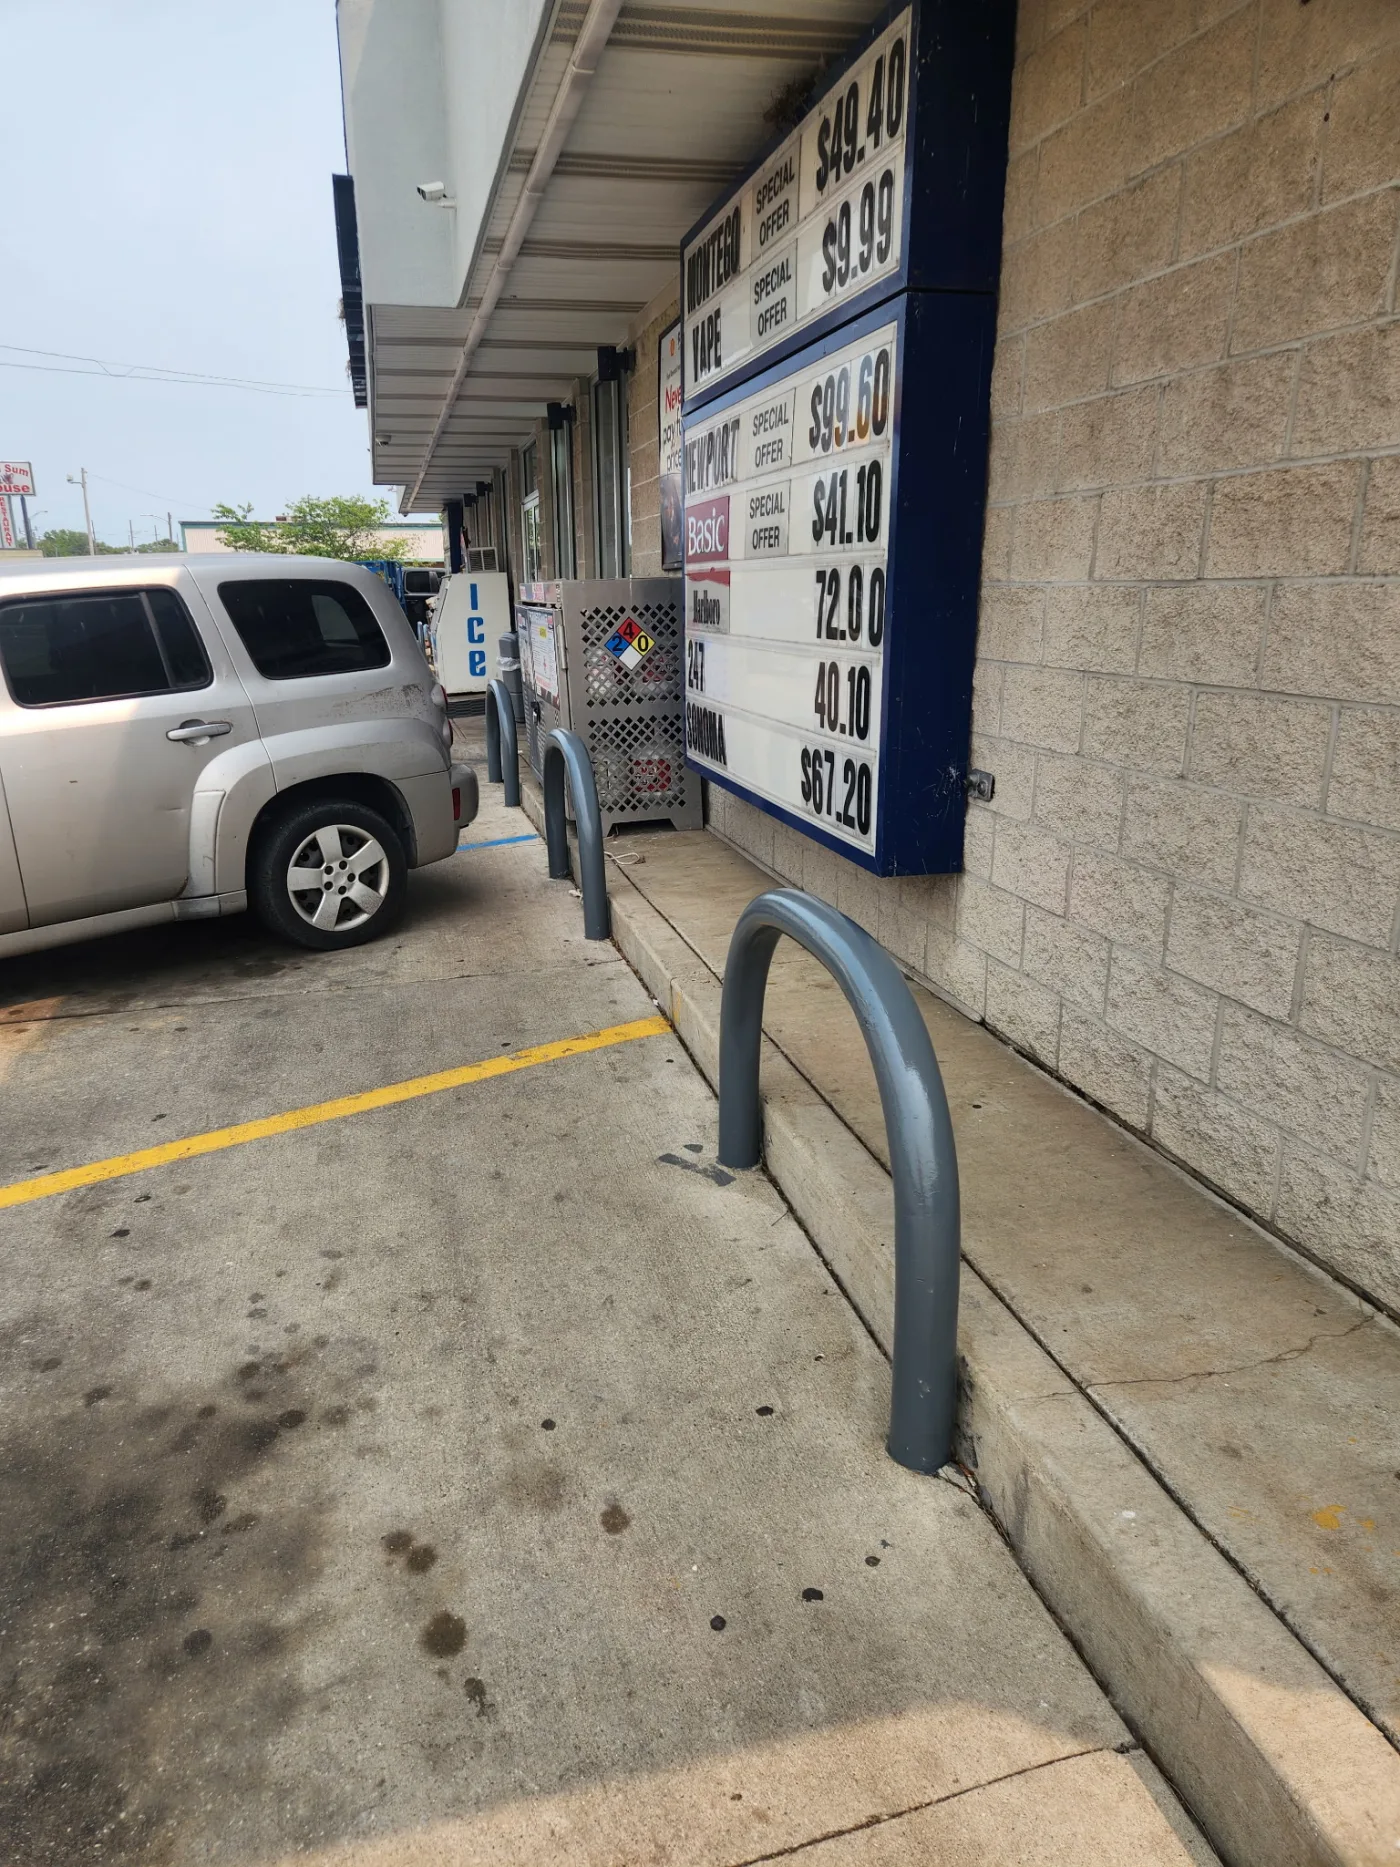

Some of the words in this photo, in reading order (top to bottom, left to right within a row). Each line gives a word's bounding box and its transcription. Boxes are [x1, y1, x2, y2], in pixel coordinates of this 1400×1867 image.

[815, 36, 905, 196] $49.40
[755, 156, 796, 215] SPECIAL
[759, 198, 790, 247] OFFER
[821, 169, 894, 295] $9.99
[687, 205, 741, 315] MONTEGO
[754, 258, 792, 306] SPECIAL
[757, 297, 787, 337] OFFER
[692, 307, 722, 383] VAPE
[752, 402, 789, 437] SPECIAL
[808, 348, 889, 453] $99.60
[4, 464, 29, 476] Sum
[685, 417, 740, 494] NEWPORT
[754, 439, 783, 468] OFFER
[750, 491, 785, 519] SPECIAL
[812, 459, 882, 547] $41.10
[688, 507, 725, 556] Basic
[752, 525, 780, 550] OFFER
[612, 635, 623, 652] 2
[637, 635, 649, 652] 0
[622, 622, 635, 639] 4
[688, 639, 705, 692] 247
[814, 661, 870, 741] 40.10
[687, 701, 728, 766] SONOMA
[800, 744, 871, 836] $67.20
